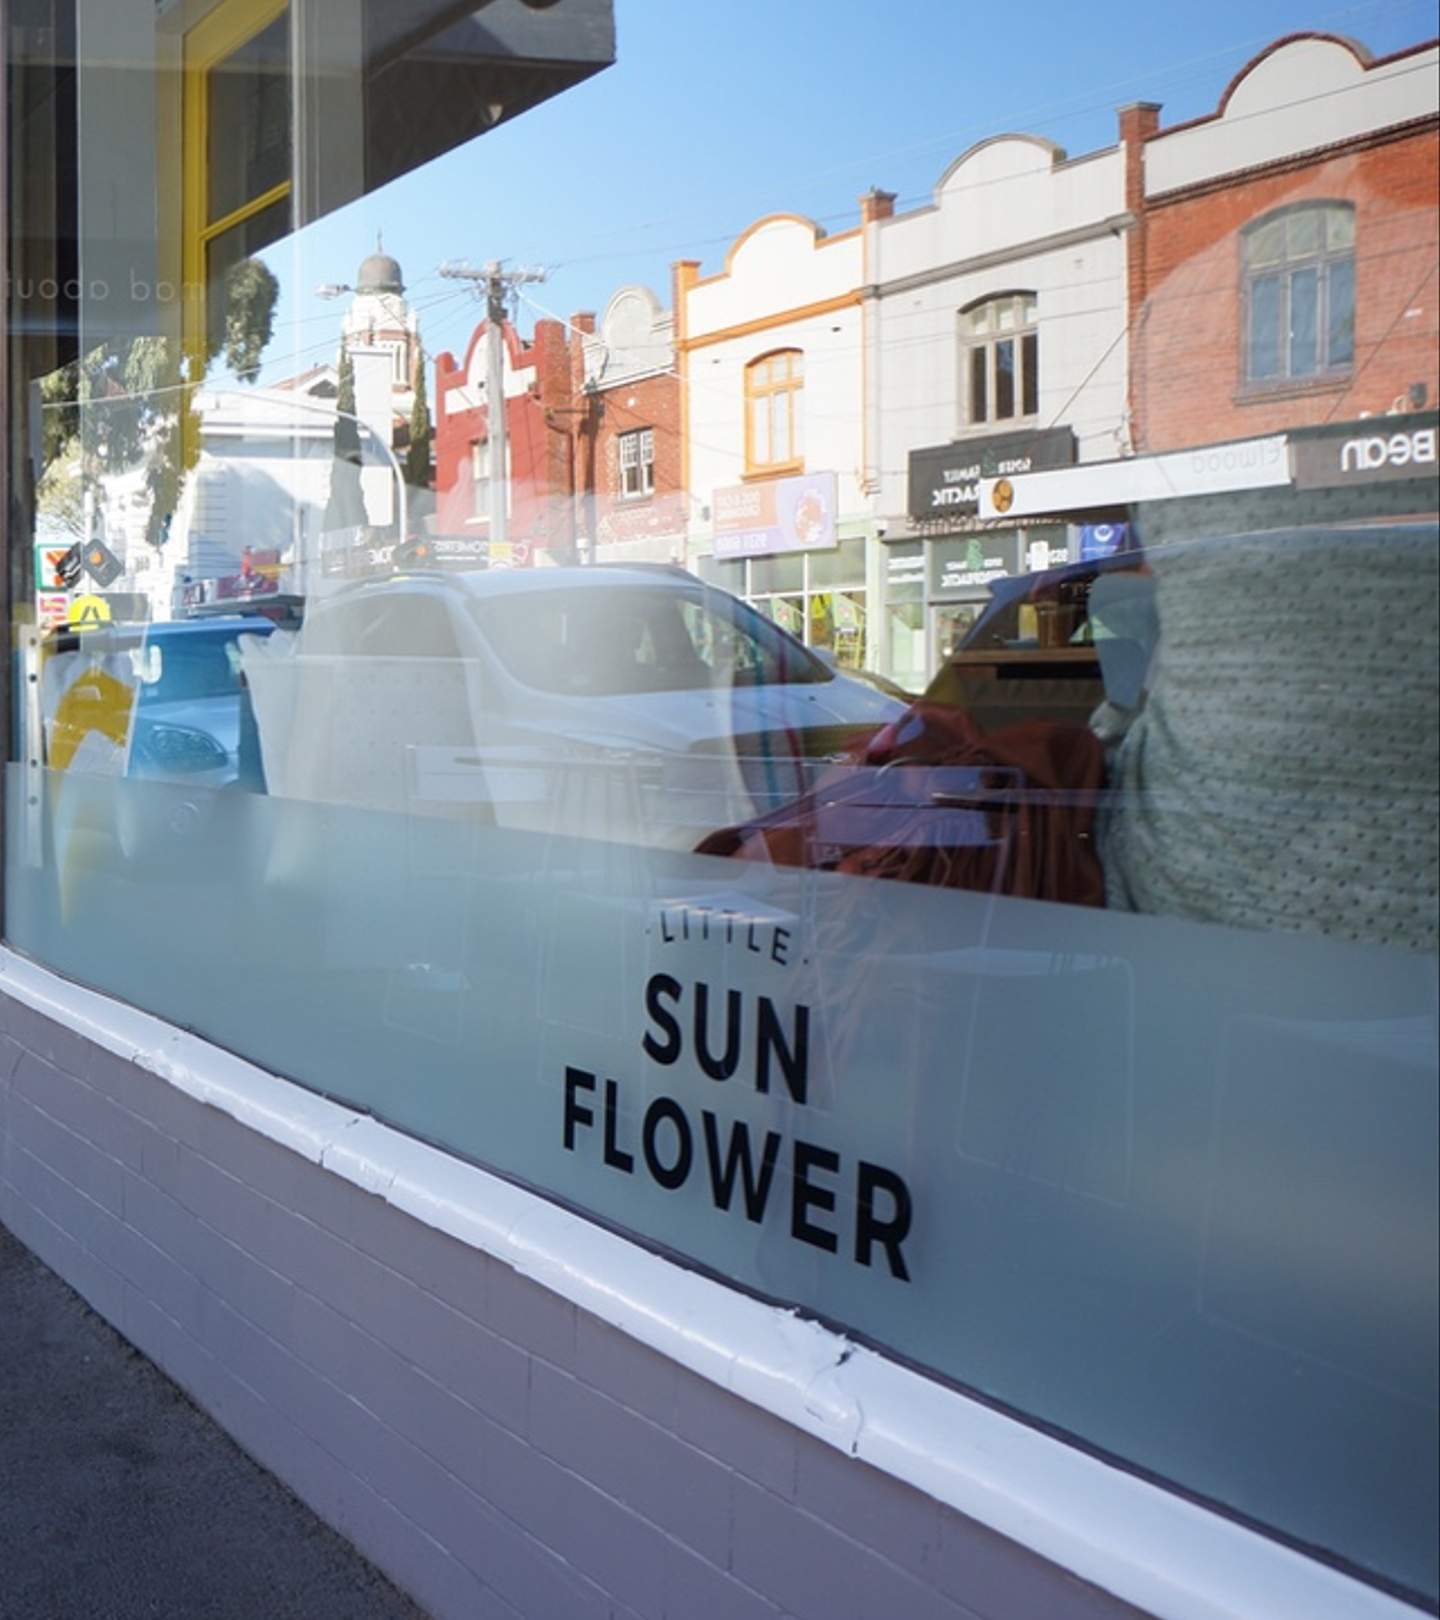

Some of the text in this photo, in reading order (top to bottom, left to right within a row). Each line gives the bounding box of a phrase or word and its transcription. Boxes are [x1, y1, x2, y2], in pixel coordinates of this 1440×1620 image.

[660, 906, 791, 966] LITTLE
[642, 972, 810, 1106] SUN
[562, 1065, 913, 1283] FLOWER
